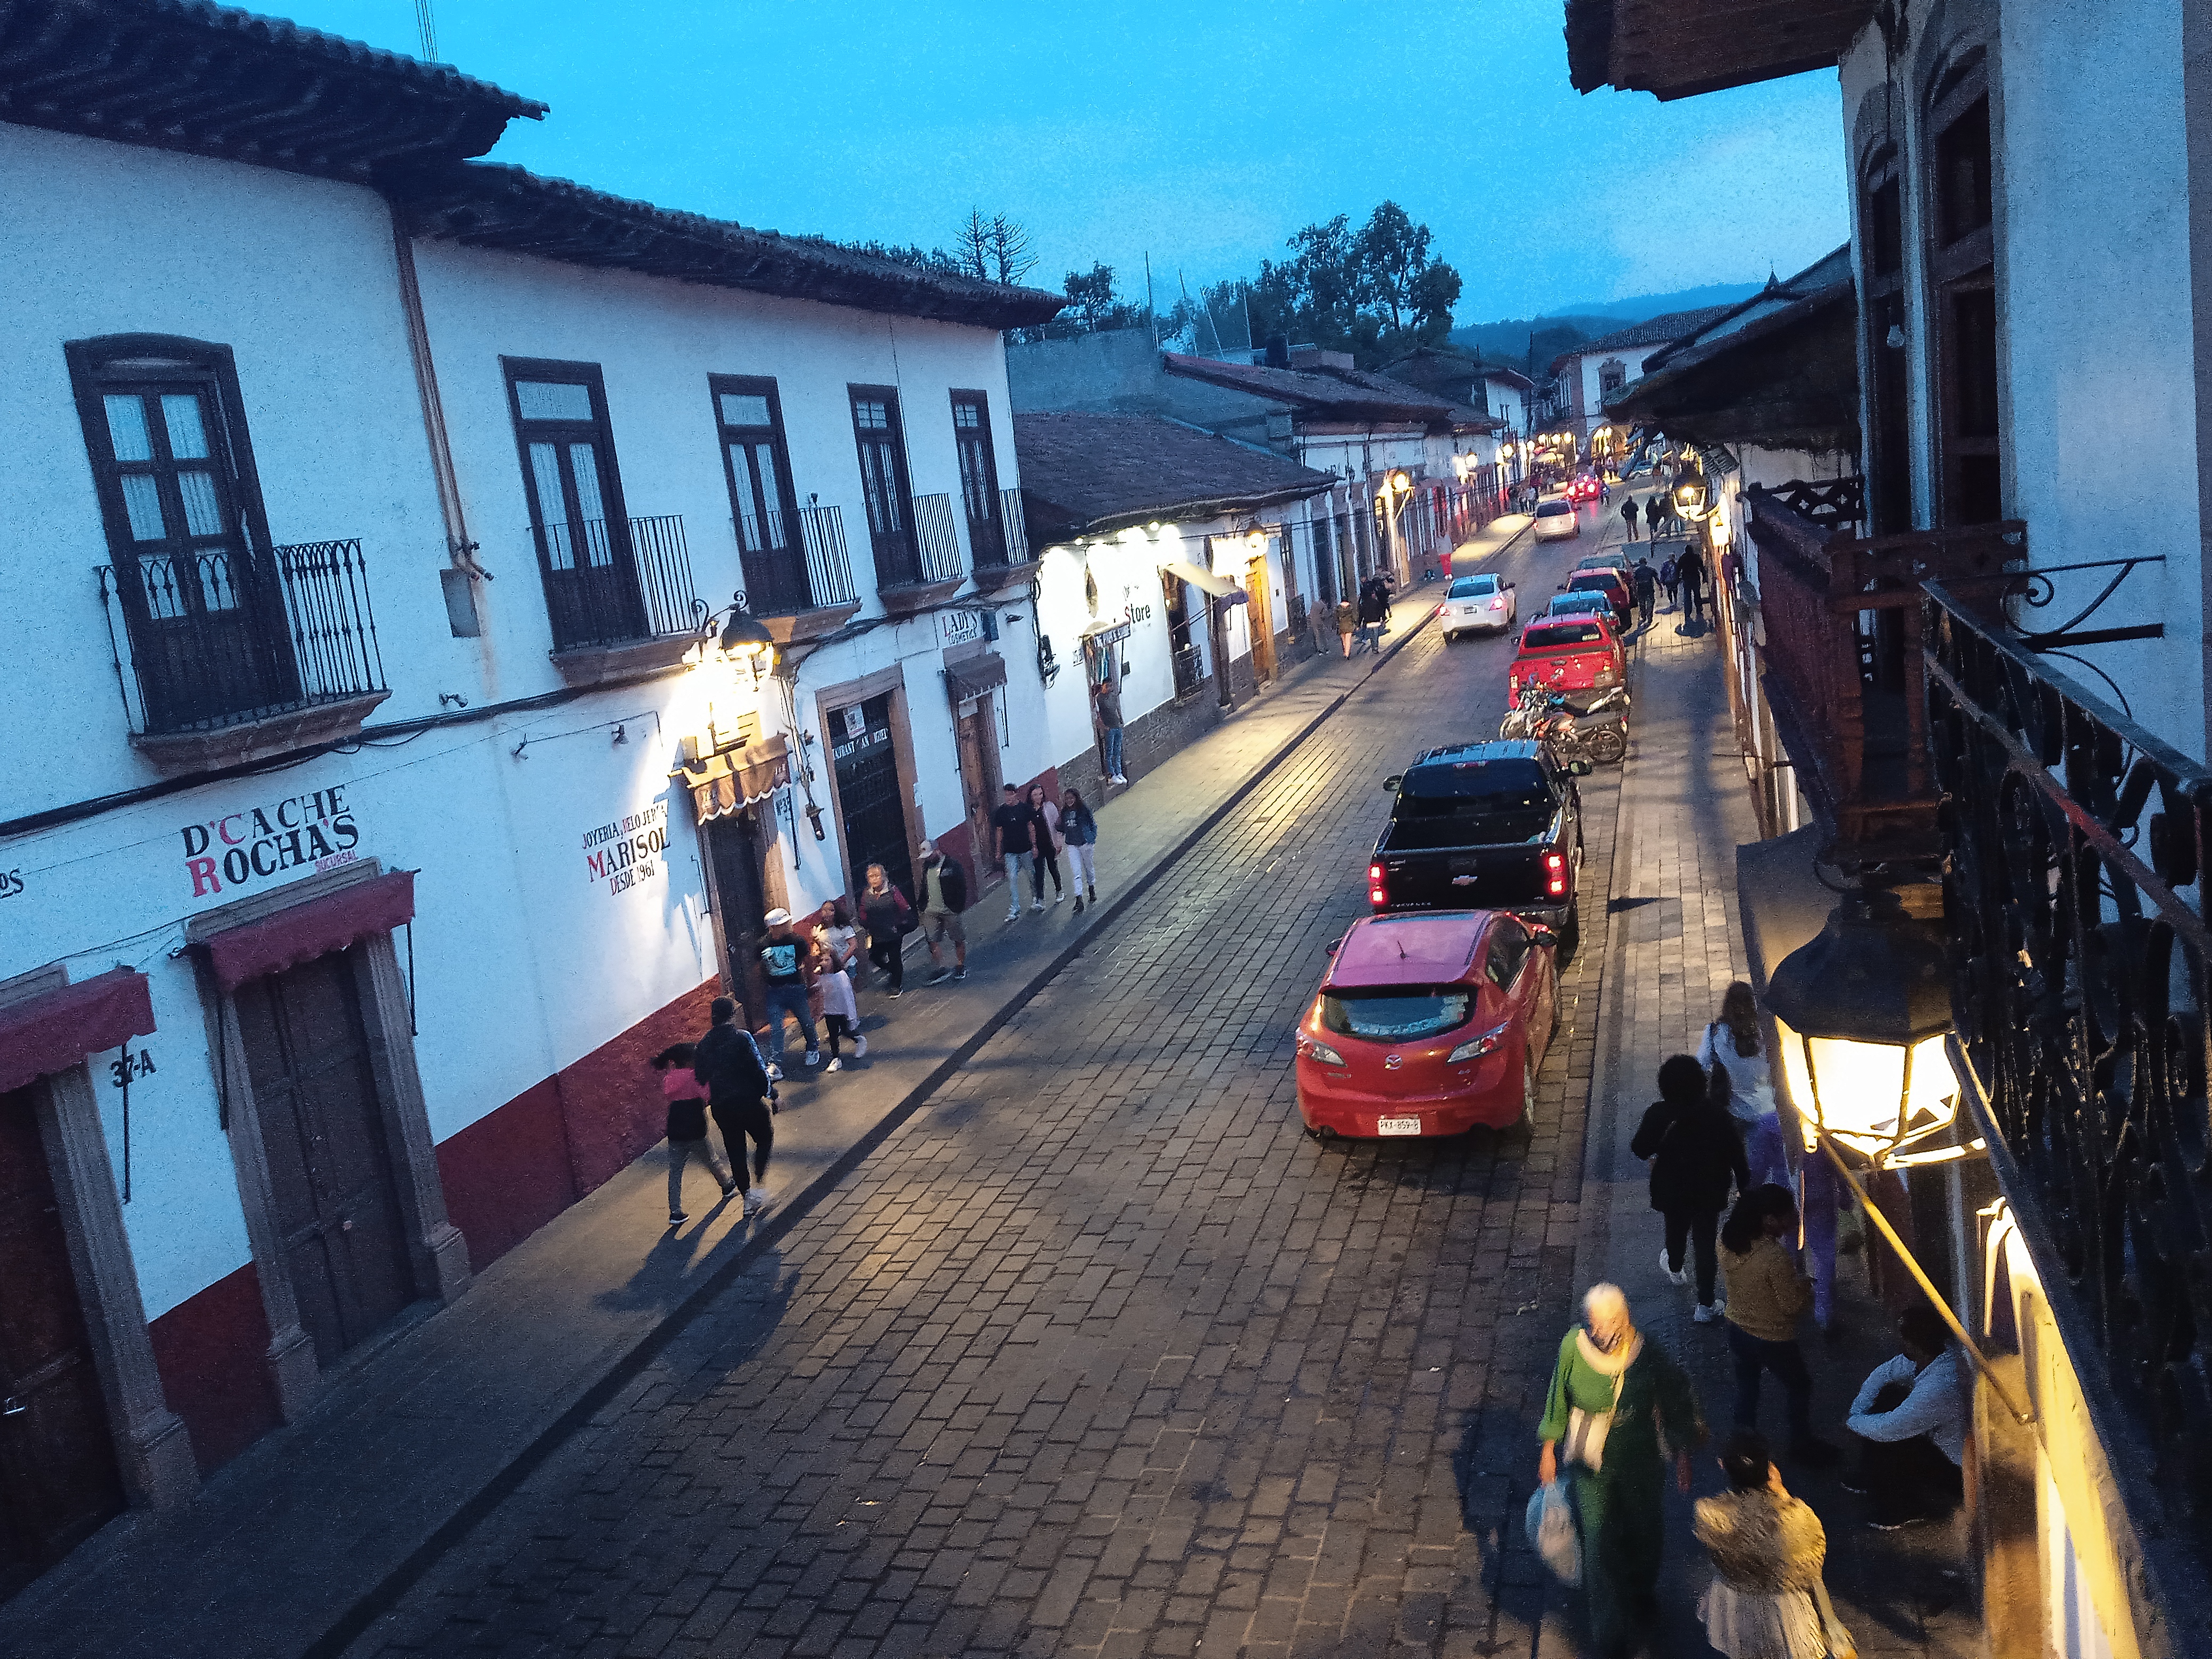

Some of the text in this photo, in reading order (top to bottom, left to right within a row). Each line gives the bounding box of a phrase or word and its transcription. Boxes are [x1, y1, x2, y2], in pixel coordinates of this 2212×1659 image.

[1125, 603, 1151, 624] Store
[186, 815, 359, 898] ROCHA'S
[315, 850, 359, 872] SUCURSAL
[586, 827, 671, 883] MARISOL
[609, 859, 655, 896] DESDE 1961
[109, 1048, 157, 1088] 37-A
